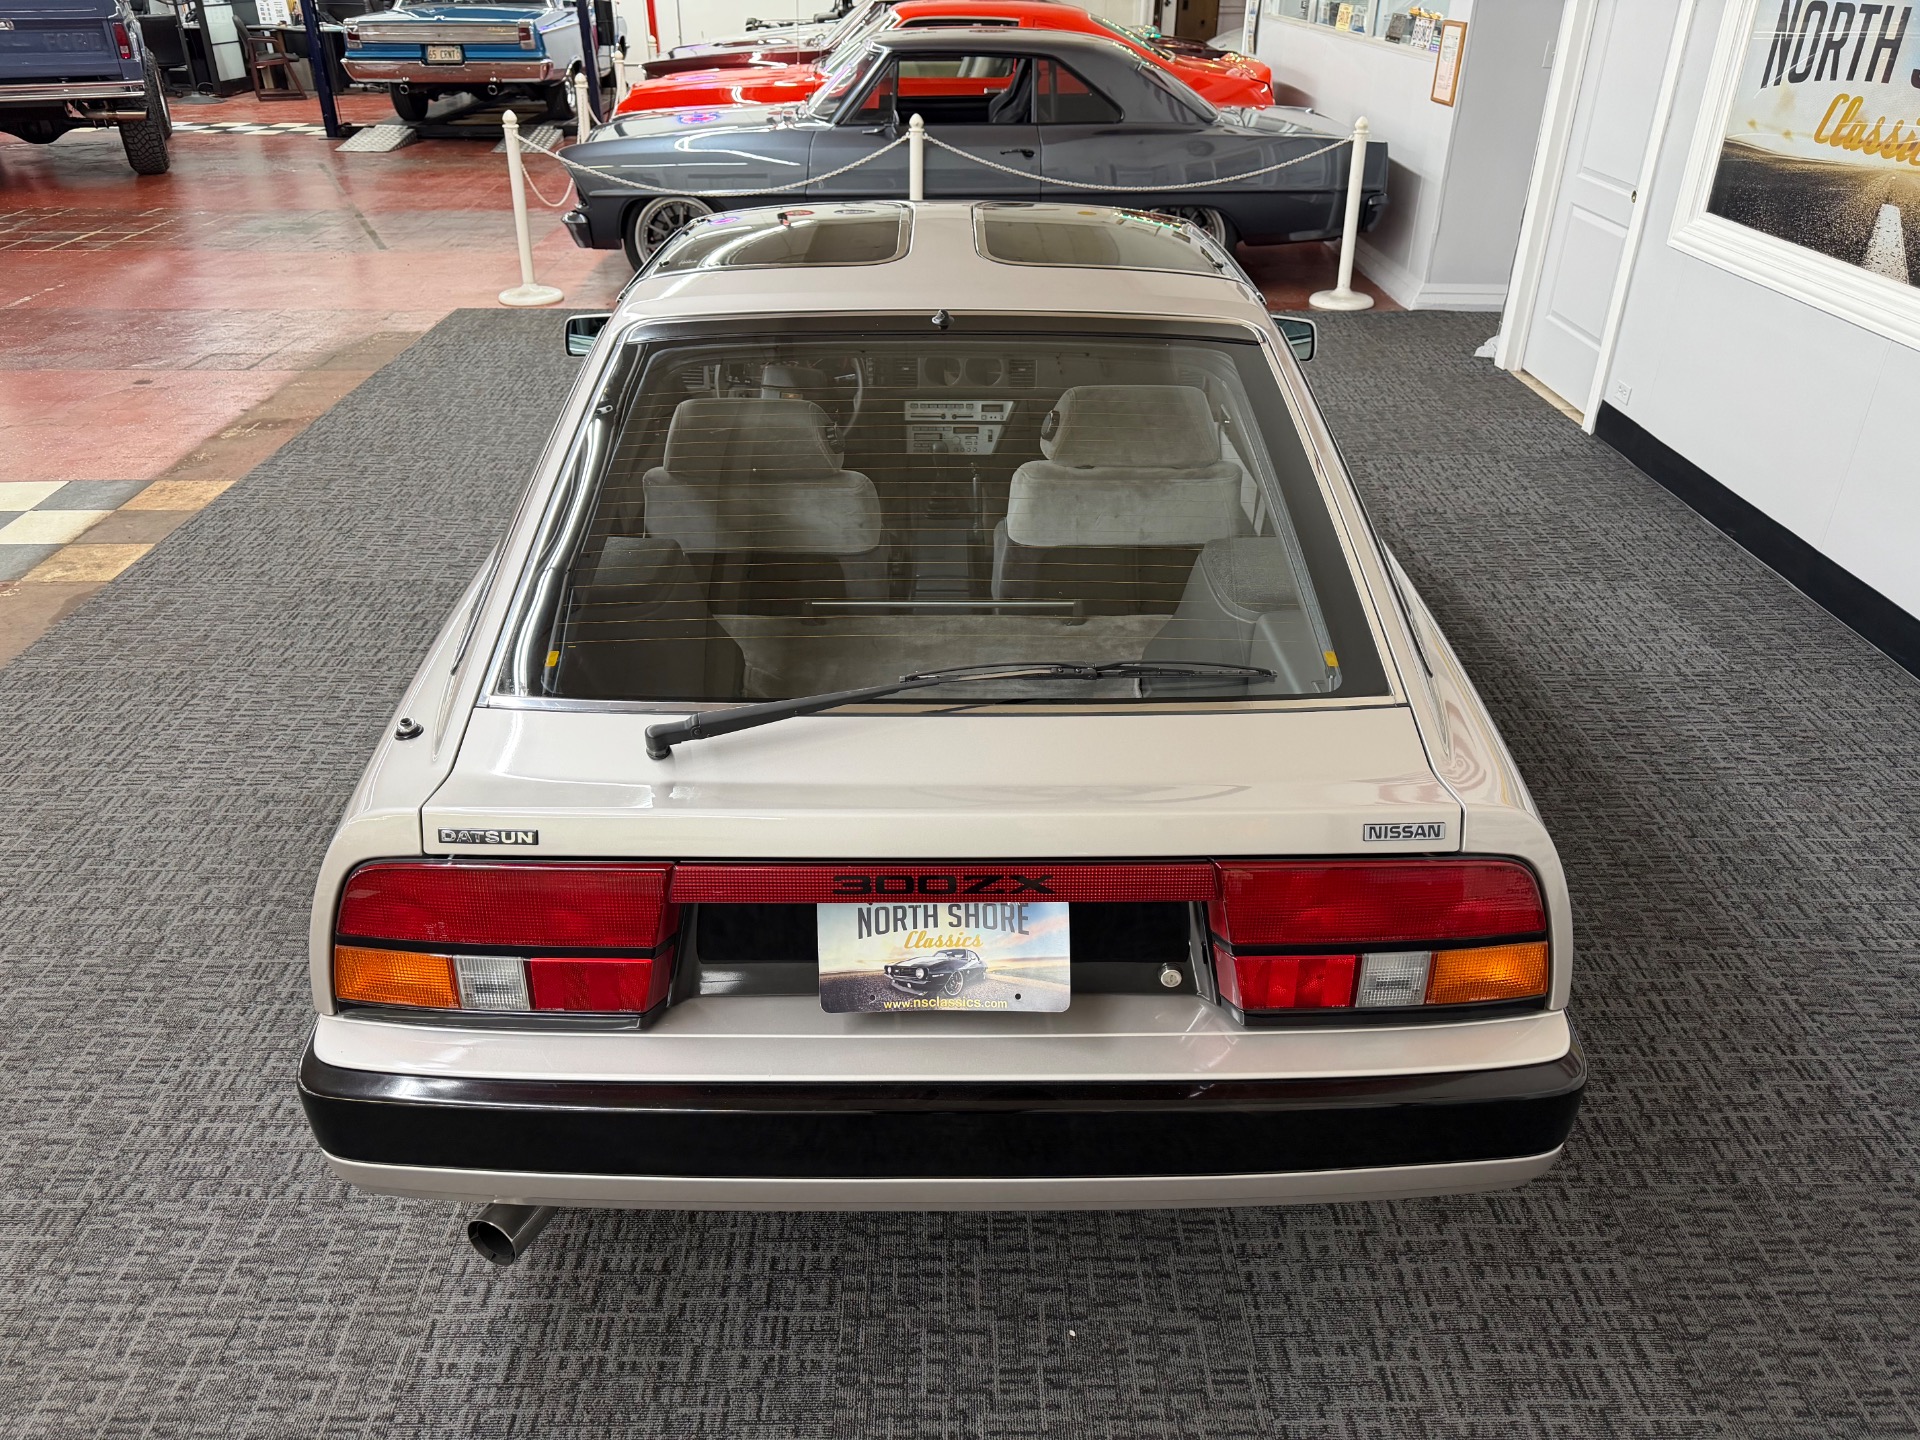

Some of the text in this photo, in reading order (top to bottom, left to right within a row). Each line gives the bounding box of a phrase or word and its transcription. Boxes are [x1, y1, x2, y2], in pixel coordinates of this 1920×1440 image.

[1760, 0, 1912, 89] NORTH
[428, 50, 437, 59] 65
[441, 829, 534, 843] DATSUN
[1368, 825, 1441, 839] NISSAN
[832, 875, 1055, 895] 300ZX
[858, 903, 1030, 939] NORTH SHORE
[903, 930, 984, 949] Classics
[883, 996, 1008, 1009] www.nsclassics.com
